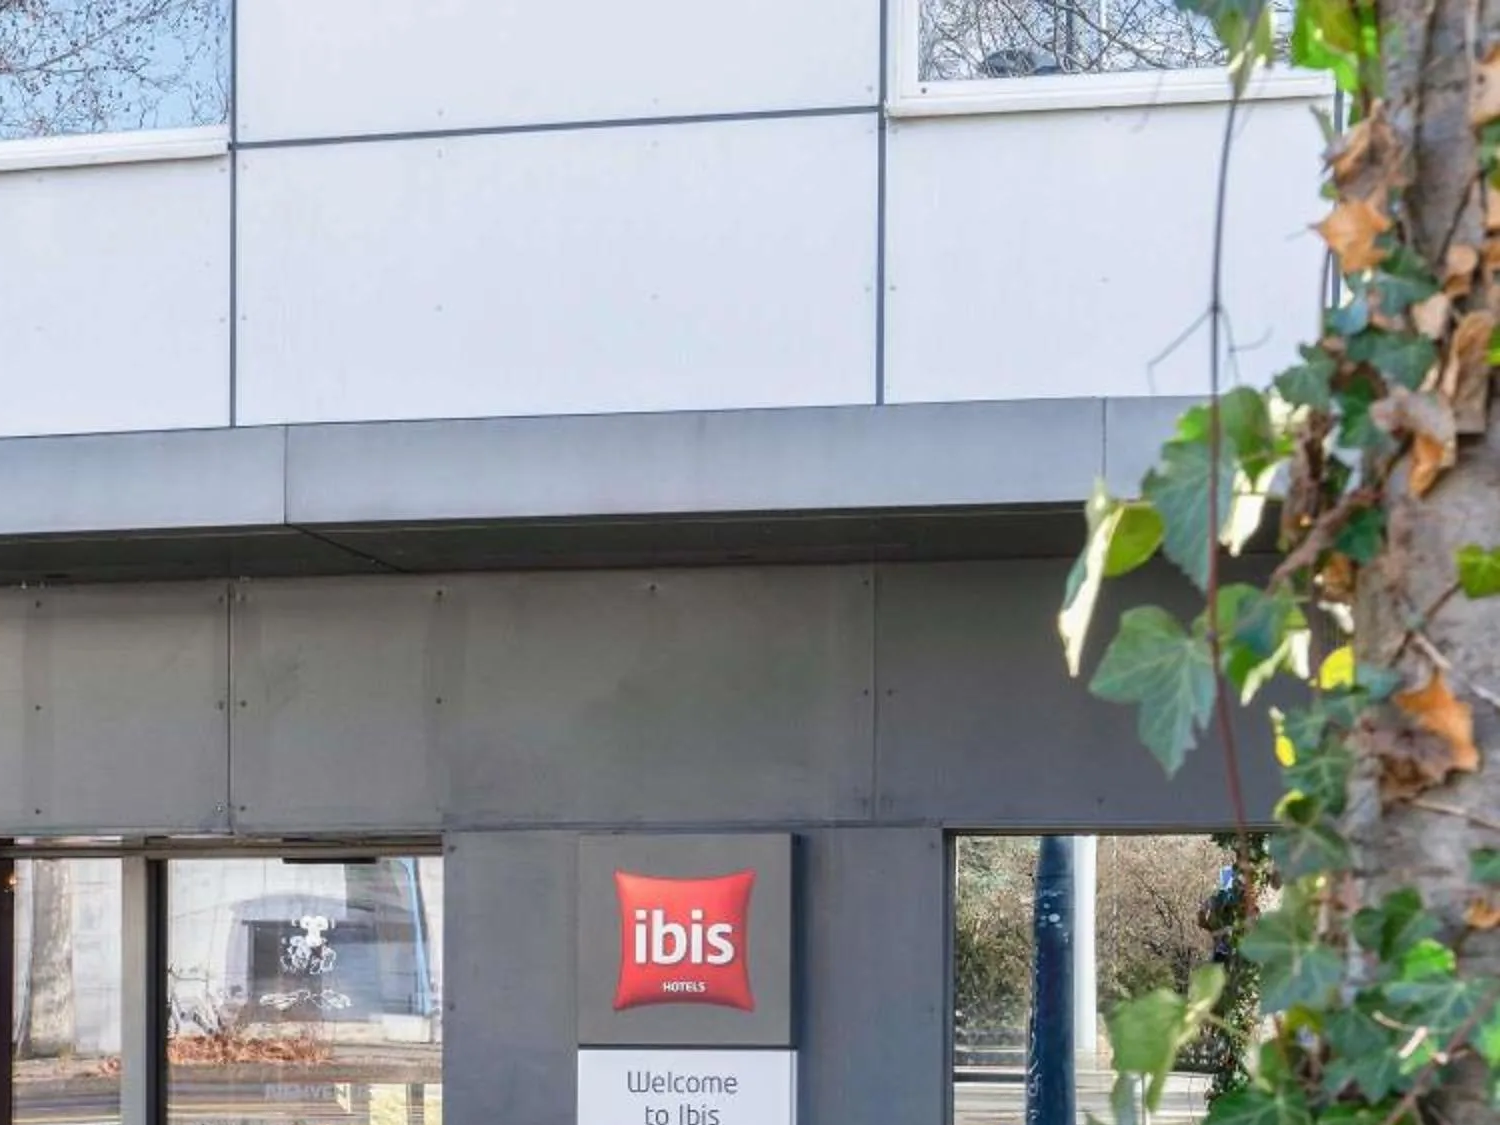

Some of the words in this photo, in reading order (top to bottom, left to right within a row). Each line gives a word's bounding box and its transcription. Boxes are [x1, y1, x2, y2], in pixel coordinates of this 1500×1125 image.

[635, 908, 734, 965] ibis
[662, 981, 706, 993] HOTELS
[627, 1071, 739, 1094] Welcome
